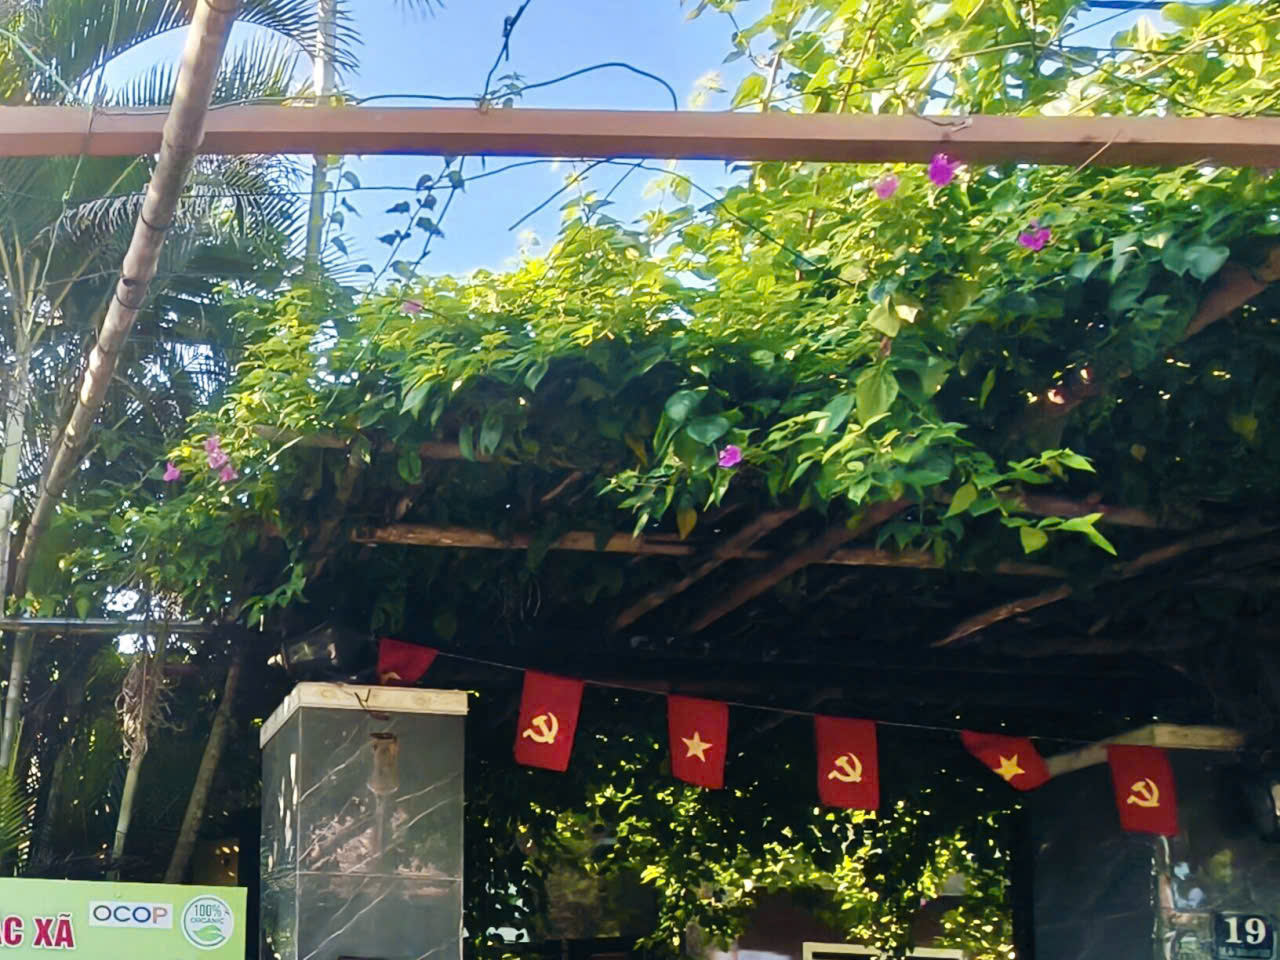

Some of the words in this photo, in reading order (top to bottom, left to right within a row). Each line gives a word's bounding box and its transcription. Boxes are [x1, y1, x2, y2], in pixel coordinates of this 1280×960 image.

[93, 905, 168, 923] OCOP
[33, 913, 75, 948] XÃ
[1224, 916, 1266, 944] 19
